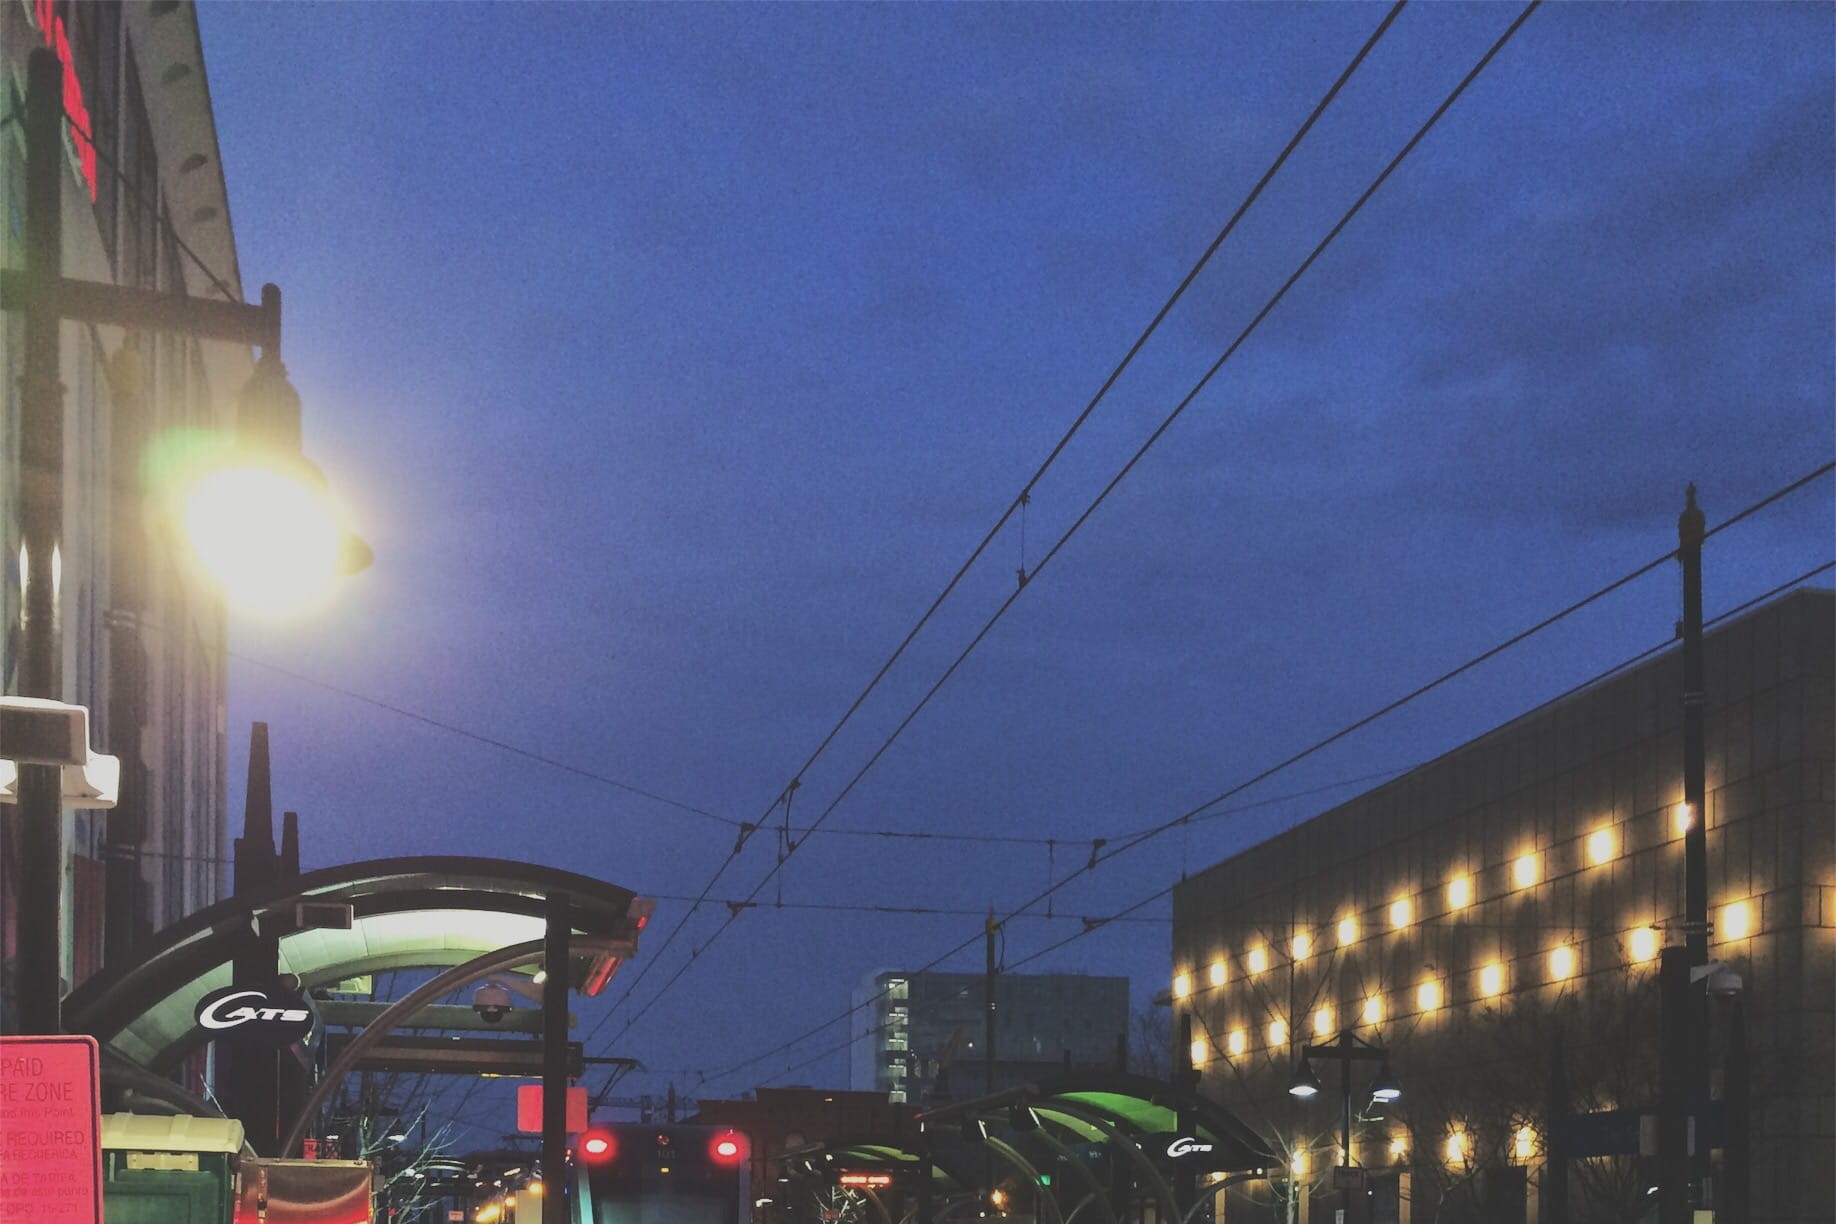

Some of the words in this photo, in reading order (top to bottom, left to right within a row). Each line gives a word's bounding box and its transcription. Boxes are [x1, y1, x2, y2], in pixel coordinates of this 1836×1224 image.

[199, 990, 310, 1030] CATS
[1, 1057, 44, 1078] PAID
[24, 1081, 73, 1102] ZONE
[7, 1130, 85, 1146] REQUIRED
